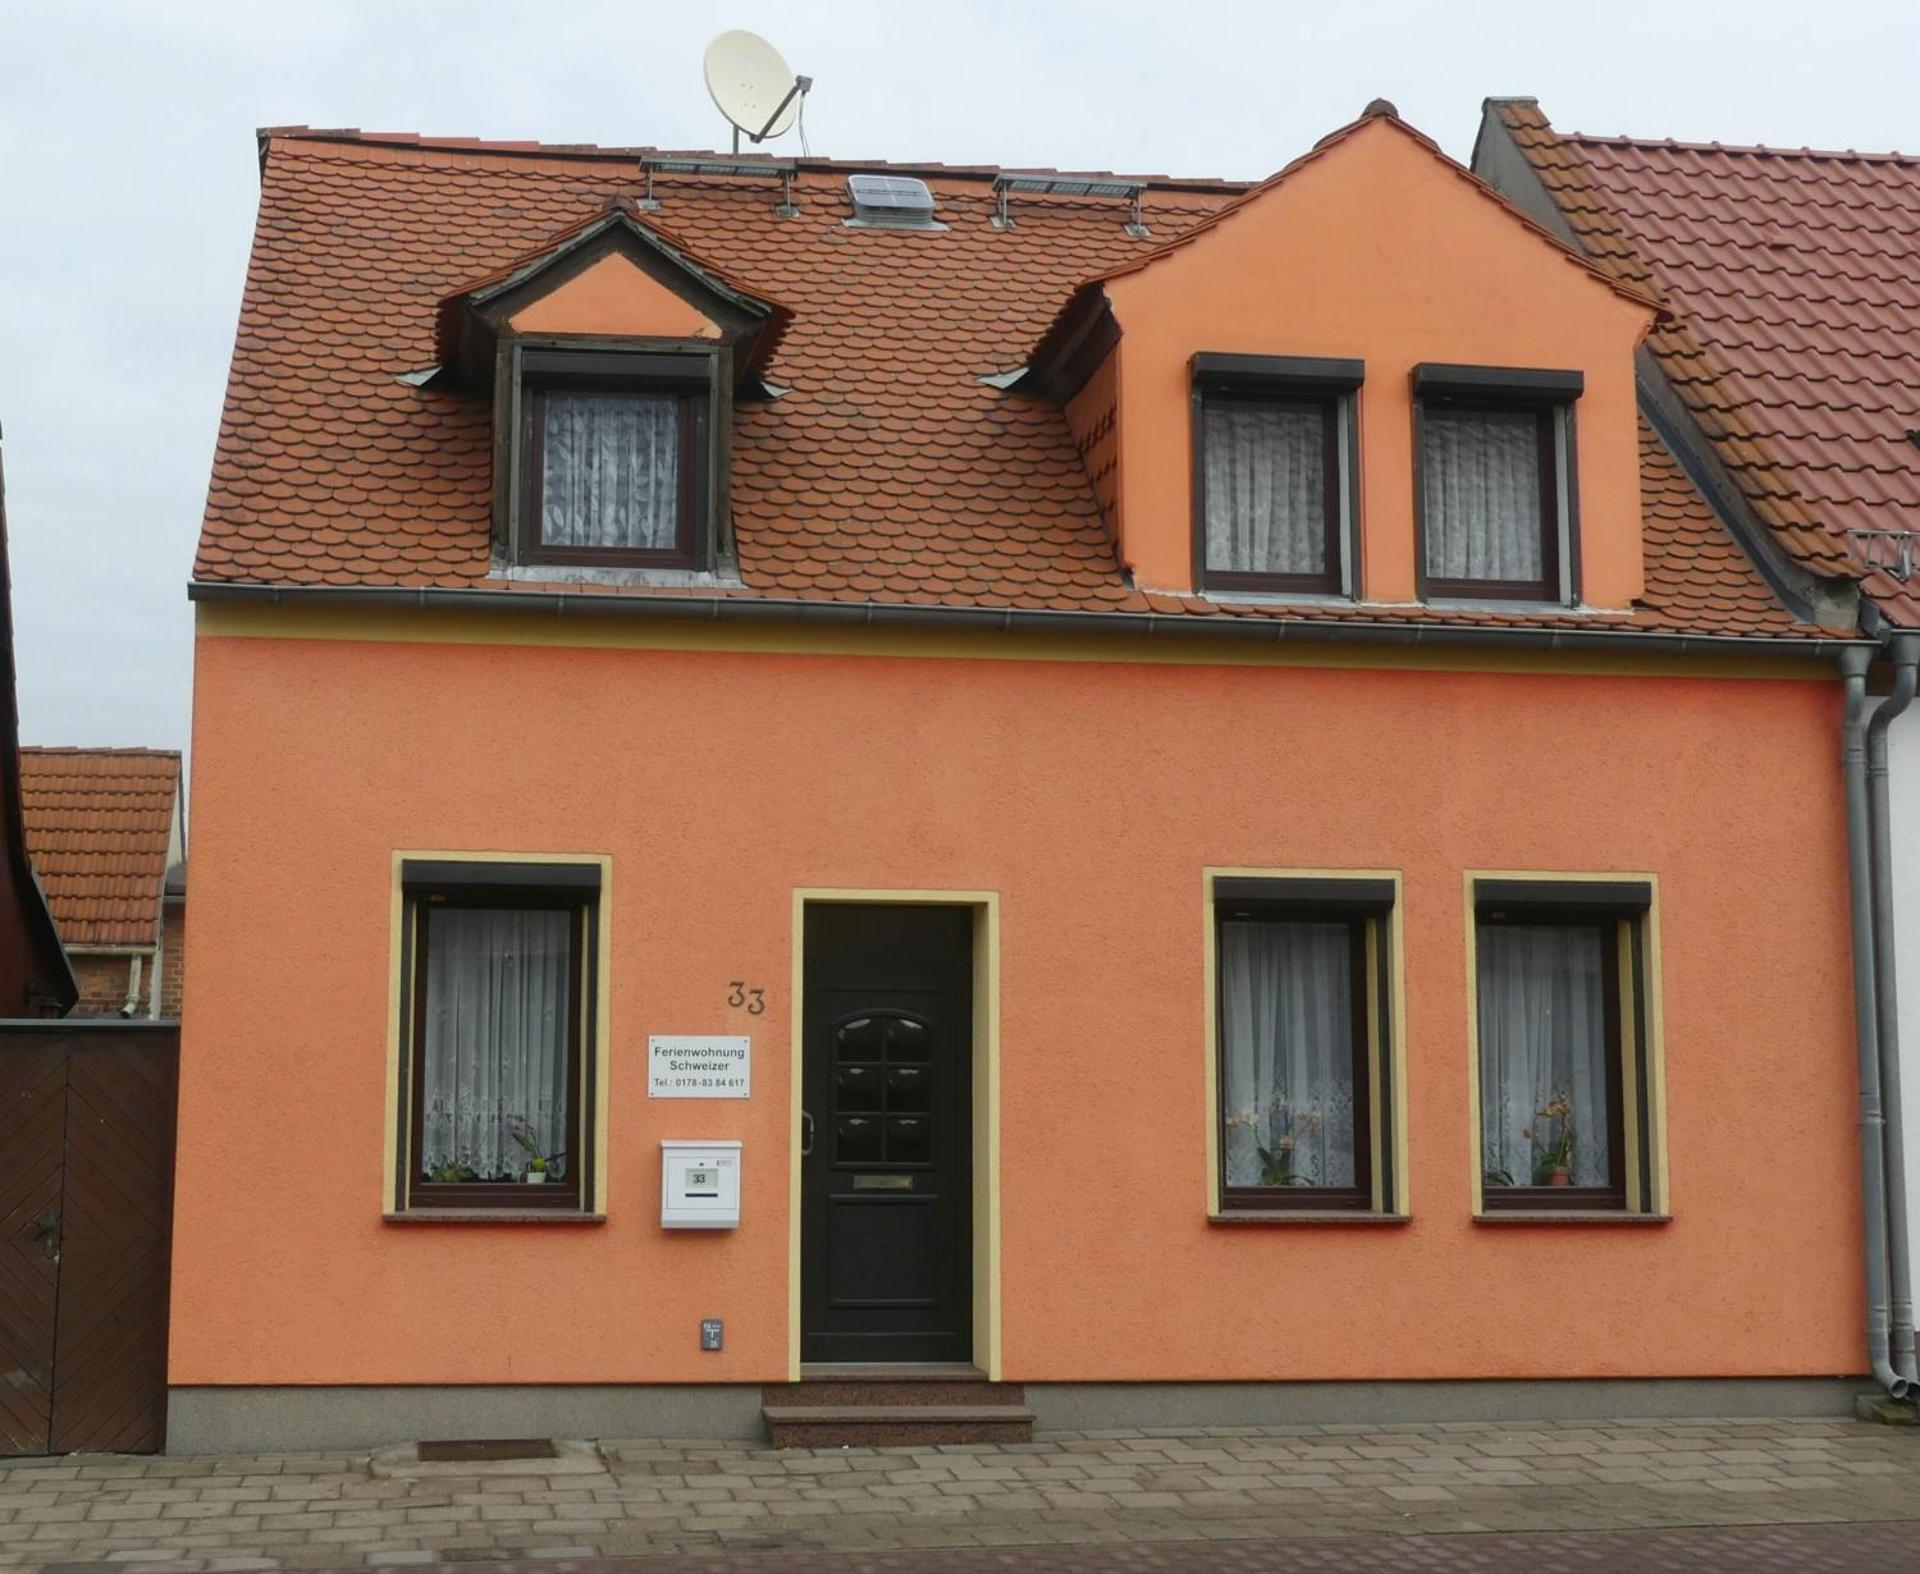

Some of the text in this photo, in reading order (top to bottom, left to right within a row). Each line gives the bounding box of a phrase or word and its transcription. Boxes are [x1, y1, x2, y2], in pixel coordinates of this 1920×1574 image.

[728, 981, 765, 1015] 33
[654, 1046, 745, 1060] Ferienwohnung
[669, 1060, 730, 1071] Schweizer
[692, 1173, 706, 1184] 33
